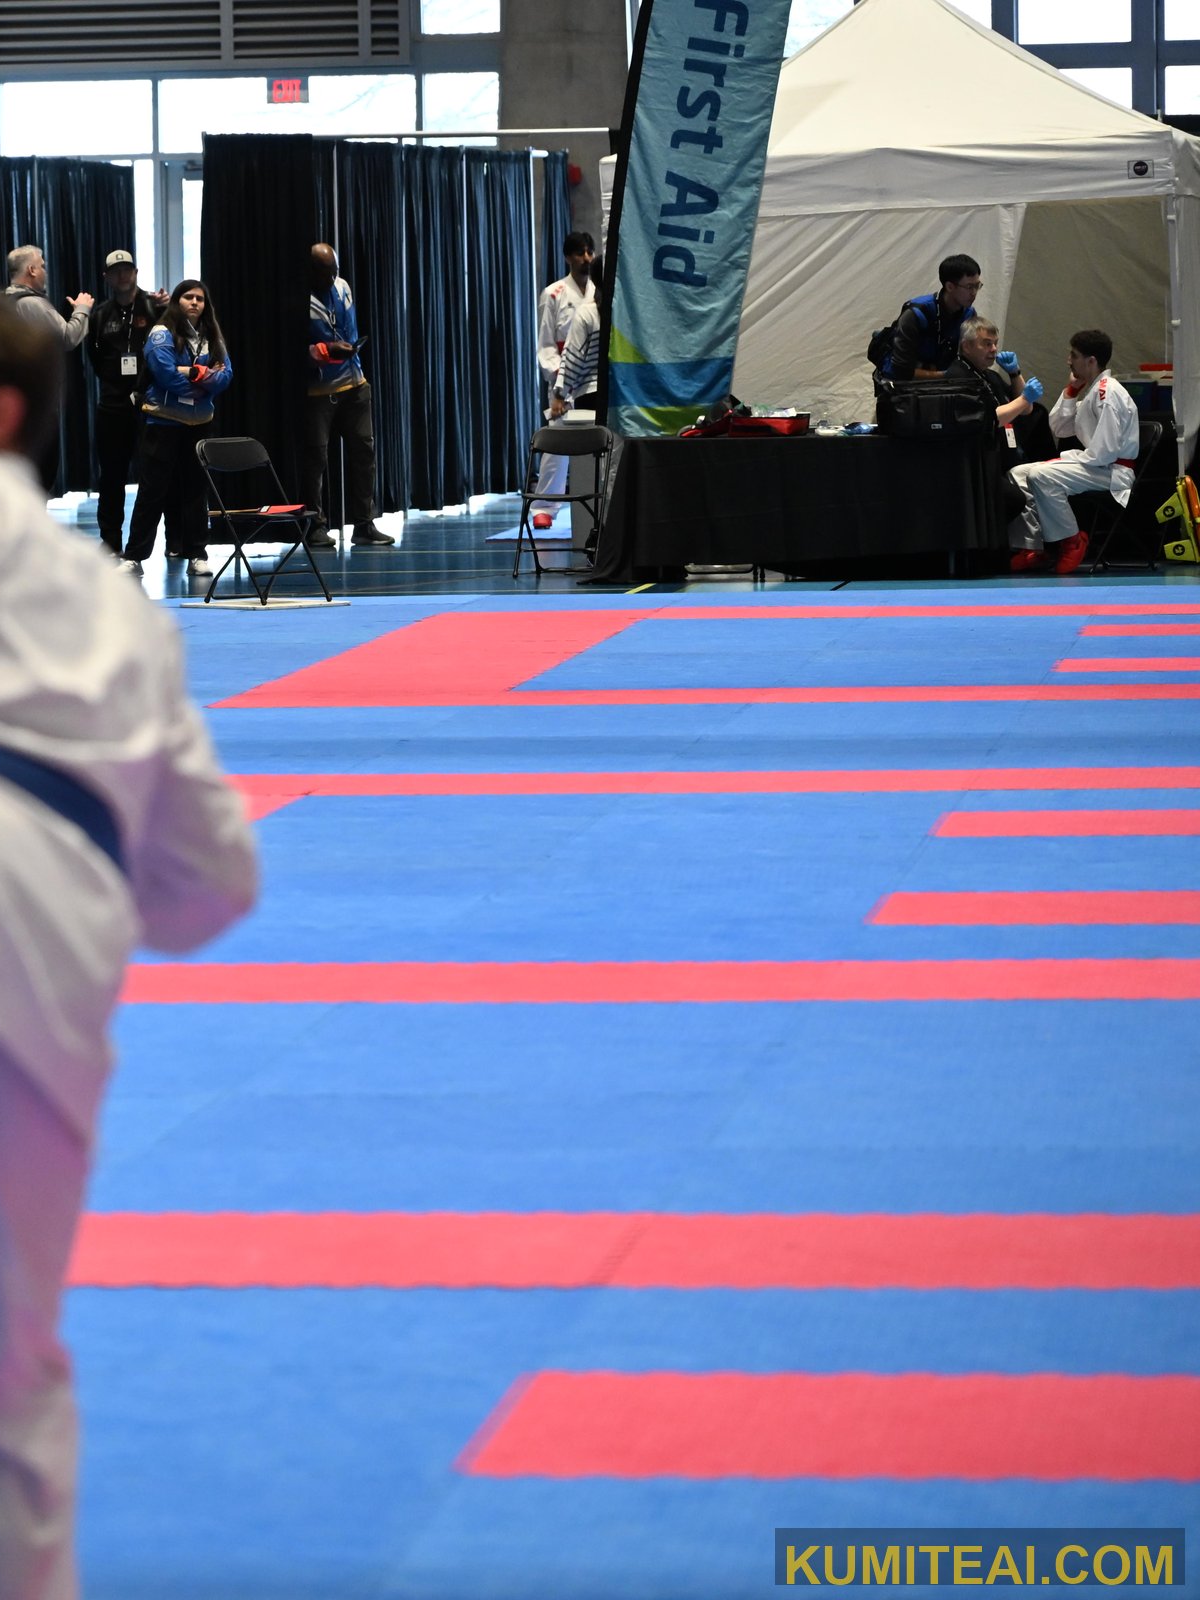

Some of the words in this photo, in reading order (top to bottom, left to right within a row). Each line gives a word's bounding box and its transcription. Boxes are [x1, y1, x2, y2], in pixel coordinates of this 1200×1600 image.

[272, 79, 302, 103] EXIT
[670, 0, 749, 154] First
[652, 170, 719, 287] Aid
